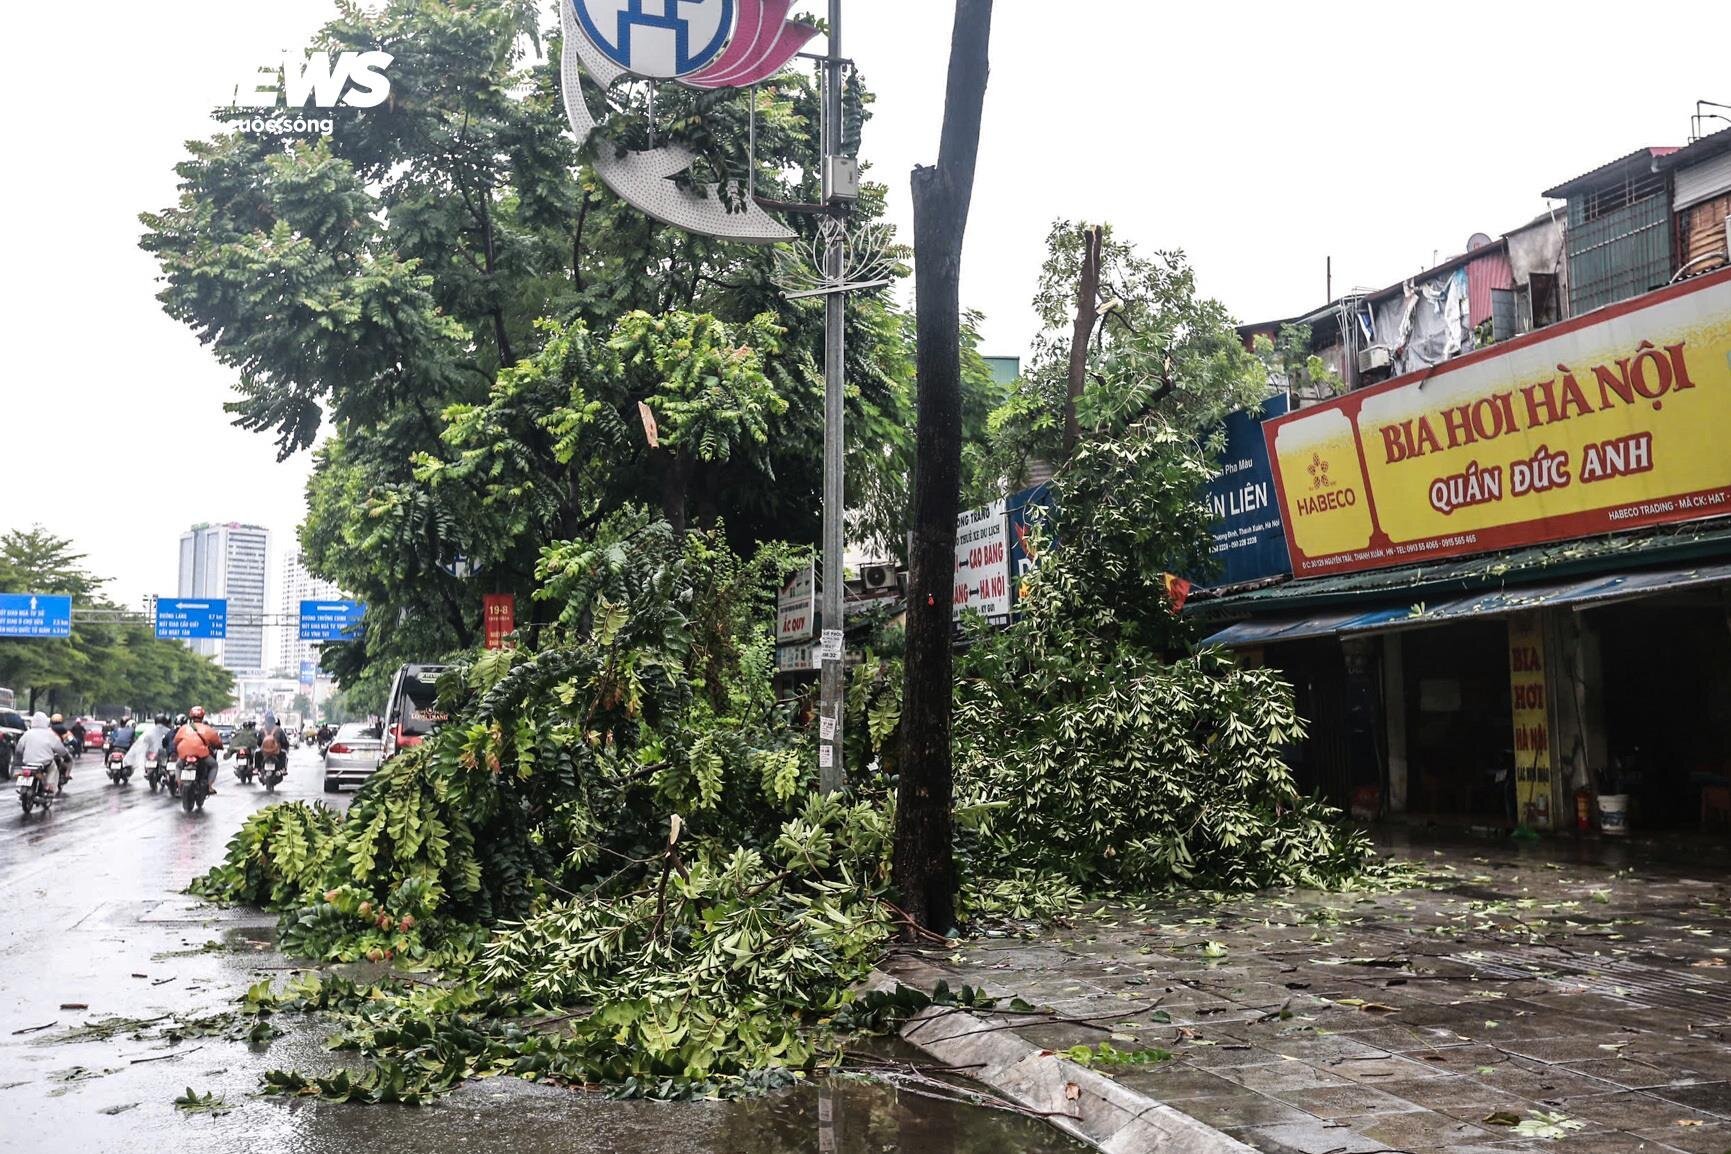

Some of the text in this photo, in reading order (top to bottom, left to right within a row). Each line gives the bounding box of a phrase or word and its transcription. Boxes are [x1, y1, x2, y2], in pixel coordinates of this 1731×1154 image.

[1379, 416, 1443, 464] BIA
[1519, 363, 1595, 429] HÀ
[1591, 339, 1696, 411] NỘI
[1225, 464, 1237, 475] Pha
[1430, 435, 1650, 513] QUÁN ĐỨC ANH
[1230, 482, 1267, 515] LIÊN
[1297, 488, 1355, 516] HABECO
[1608, 507, 1639, 520] HABECO
[1640, 501, 1674, 515] TRADING
[1708, 492, 1725, 505] HAT
[970, 547, 982, 569] CAO
[490, 605, 508, 614] 19-8
[1512, 646, 1542, 672] BIA
